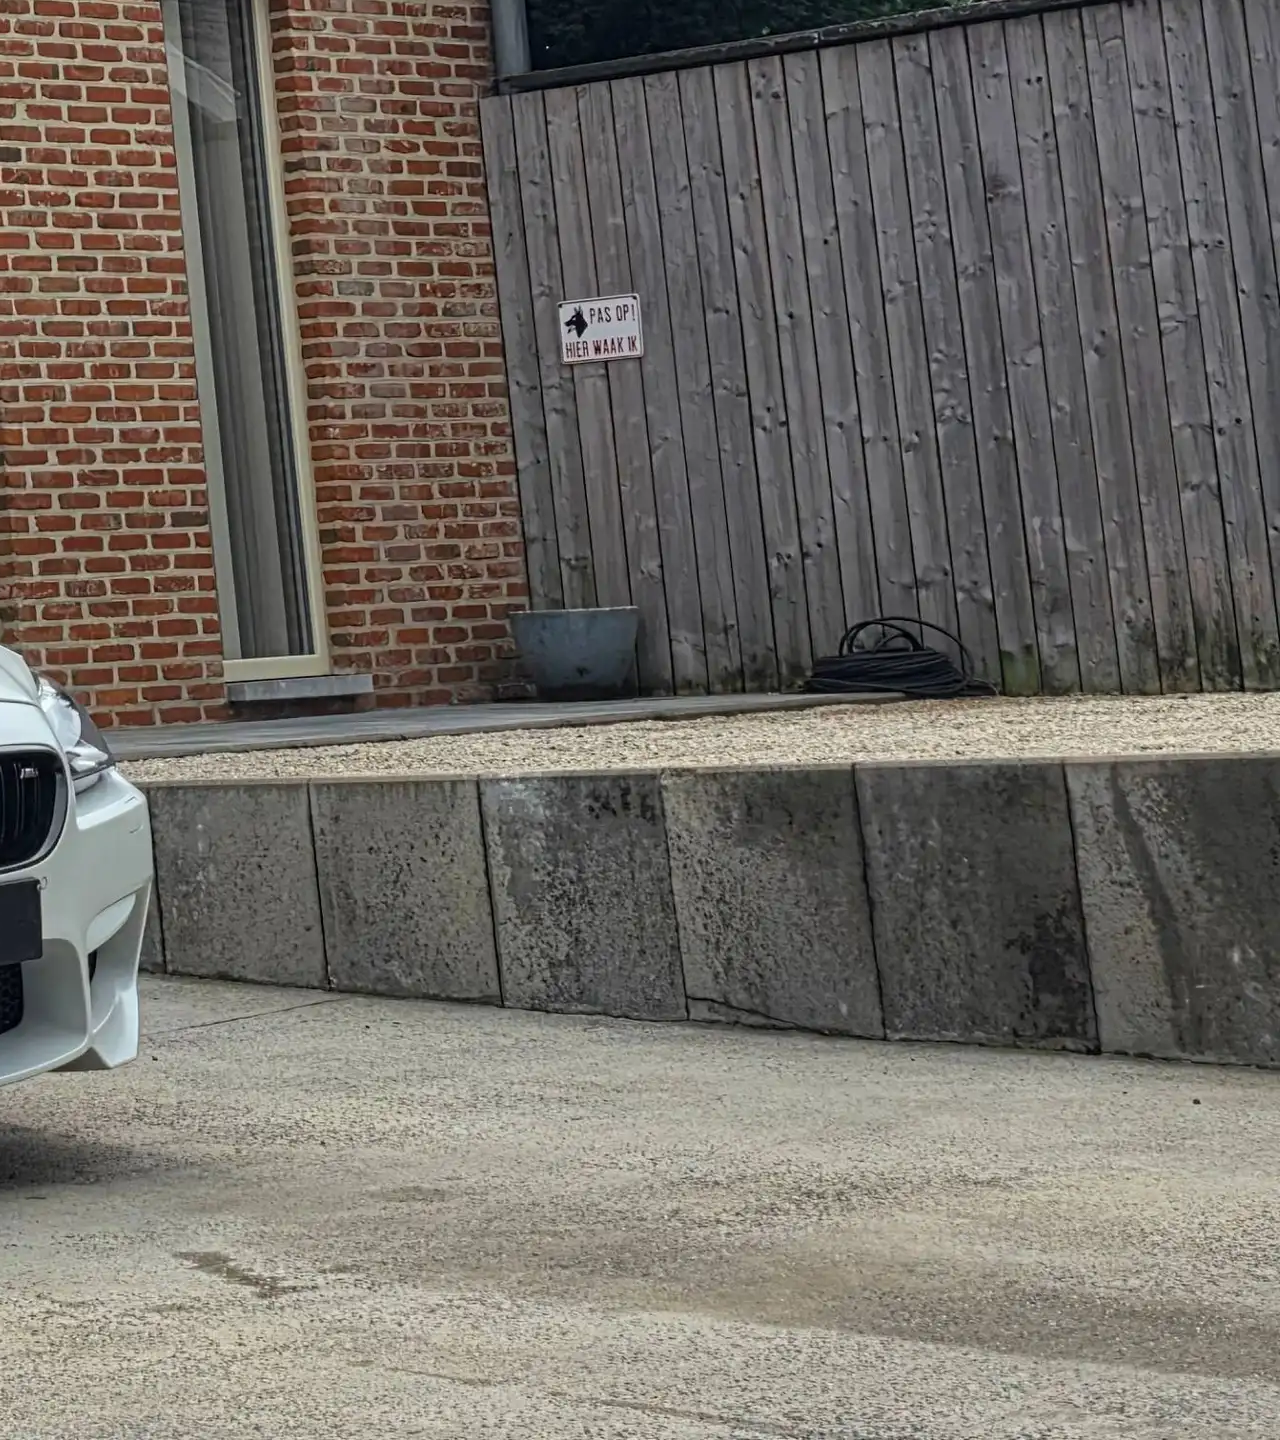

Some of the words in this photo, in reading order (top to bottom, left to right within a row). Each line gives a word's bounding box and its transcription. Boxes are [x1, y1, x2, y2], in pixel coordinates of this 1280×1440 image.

[589, 306, 612, 324] PAS
[616, 304, 636, 322] OP!
[565, 340, 590, 359] HIER
[593, 337, 624, 356] WAAK
[627, 336, 638, 352] IK
